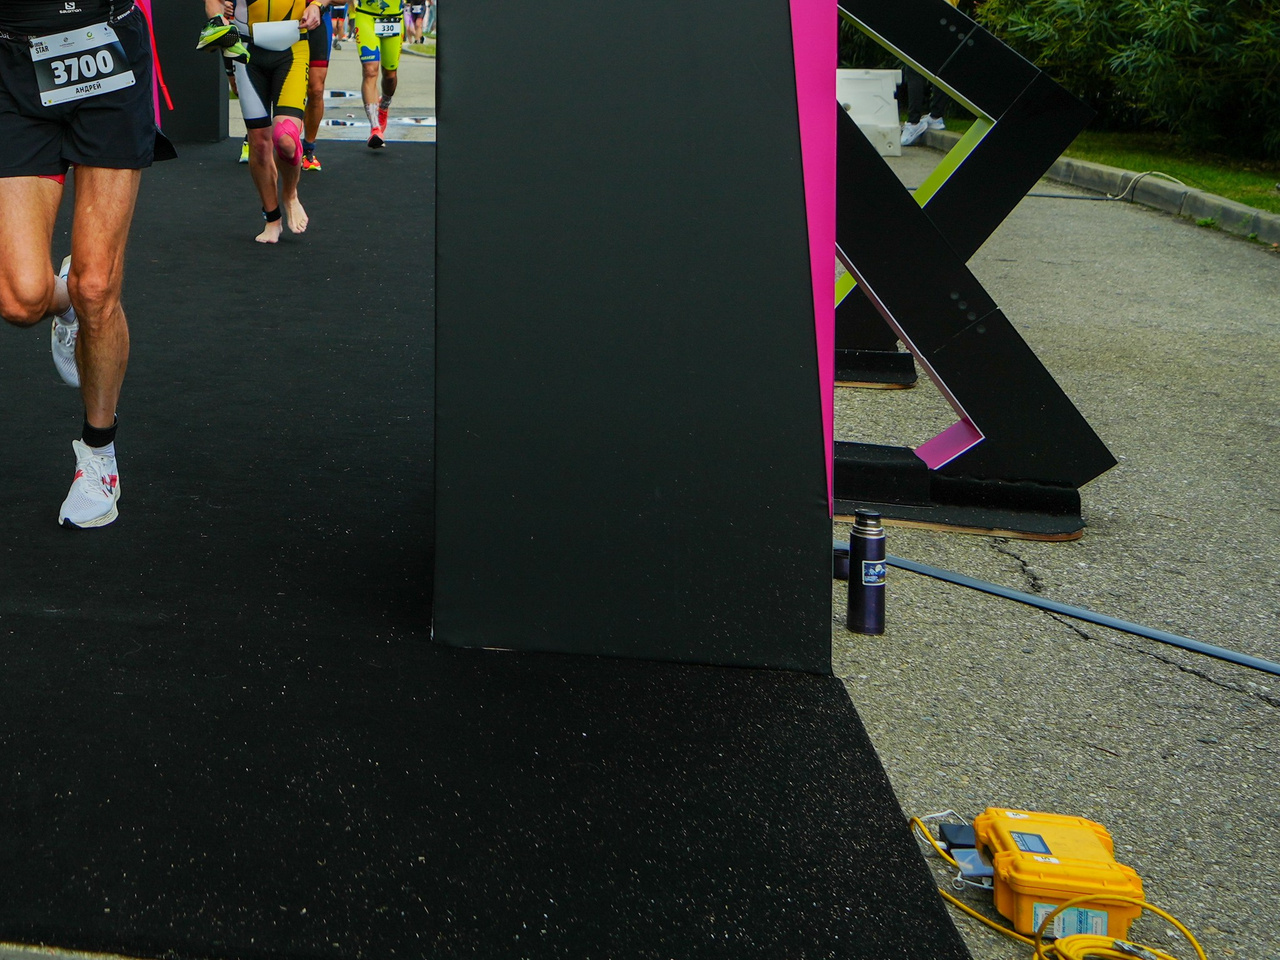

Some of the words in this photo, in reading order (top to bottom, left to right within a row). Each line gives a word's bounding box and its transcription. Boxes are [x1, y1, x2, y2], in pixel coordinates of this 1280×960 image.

[35, 46, 50, 55] STAR
[50, 49, 114, 85] 3700
[75, 81, 102, 94] АНДРЕЙ
